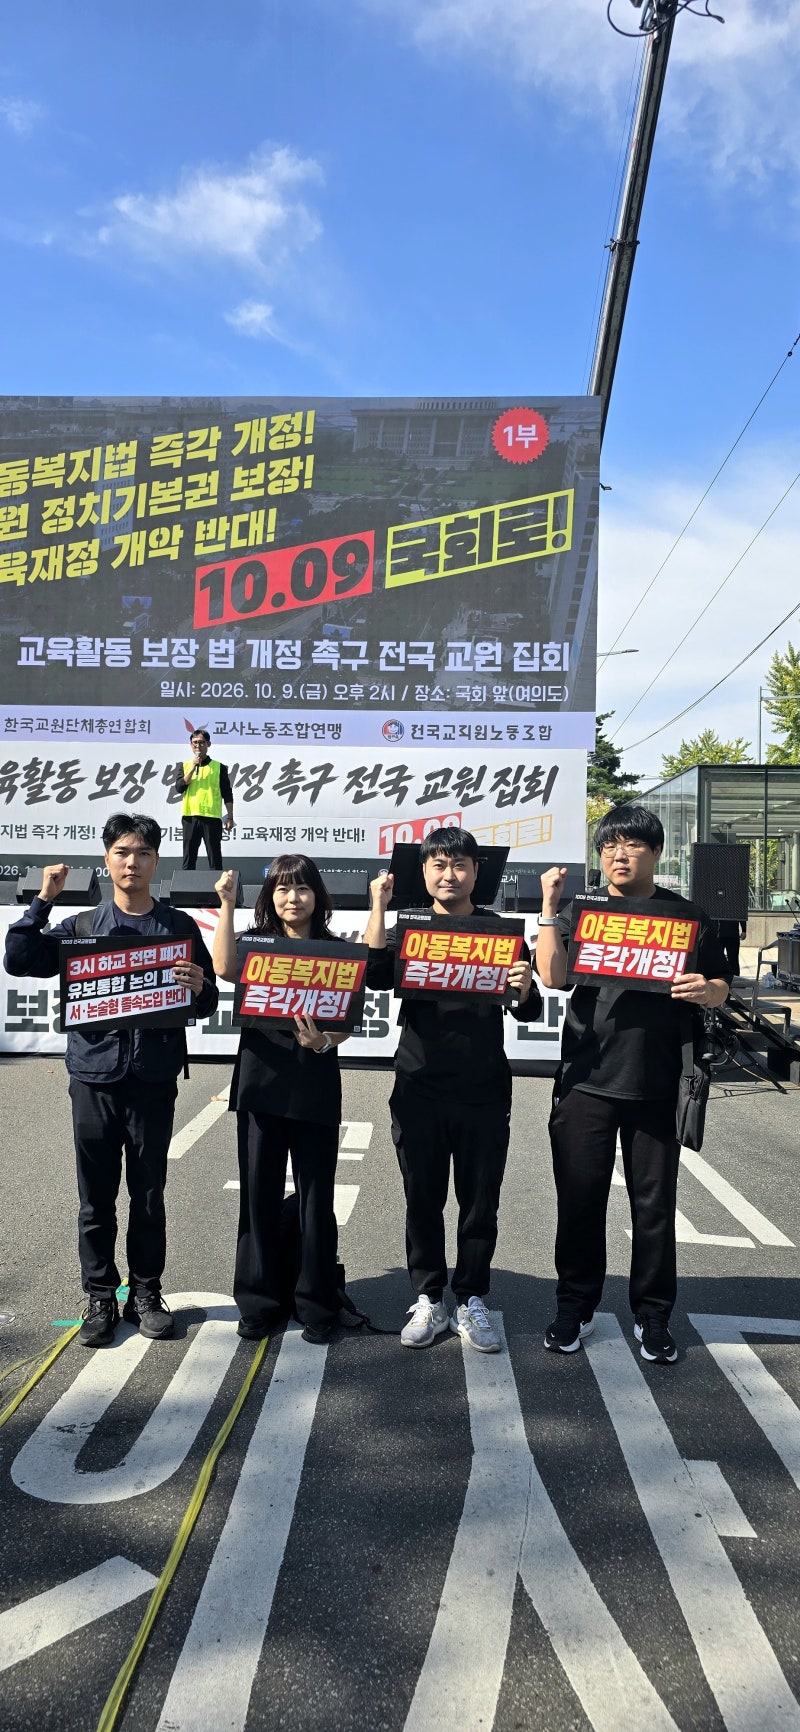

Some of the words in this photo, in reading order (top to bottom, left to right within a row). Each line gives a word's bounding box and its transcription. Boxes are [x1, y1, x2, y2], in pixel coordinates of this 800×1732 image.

[502, 424, 538, 449] 1부
[0, 440, 138, 498] 동복지법
[149, 425, 222, 468] 즉각
[231, 410, 316, 457] 개정!
[0, 502, 29, 542] 원
[41, 470, 219, 536] 정치기본권
[230, 454, 315, 502] 보장!
[0, 538, 100, 587] 육재정
[111, 524, 184, 570] 개악
[194, 508, 278, 556] 반대!
[198, 538, 371, 622] 10.09
[386, 489, 573, 588] 국회로!
[17, 636, 132, 668] 교육활동
[141, 638, 199, 669] 보장
[208, 639, 235, 669] 법
[247, 639, 301, 671] 개정
[312, 640, 368, 671] 촉구
[379, 641, 435, 672] 전국
[445, 642, 501, 672] 교원
[513, 641, 569, 673] 집회
[160, 681, 195, 698] 일시:
[201, 683, 248, 698] 2026.
[254, 683, 276, 699] 10.
[333, 684, 364, 701] 오후
[370, 684, 396, 702] 2시
[401, 685, 409, 701] /
[415, 685, 449, 702] 장소:
[456, 685, 487, 702] 국회
[492, 684, 569, 702] 앞(여의도)
[4, 717, 151, 734] 한국교원단체총연합회
[213, 721, 342, 740] 교사노동조합연맹
[411, 724, 552, 741] 전국교직원노동조합
[0, 757, 88, 805] 육활동
[88, 759, 158, 804] 보장
[272, 758, 339, 806] 촉구
[343, 763, 415, 808] 전국
[415, 765, 488, 808] 교원
[489, 765, 559, 808] 집회
[1, 824, 28, 839] 지법
[32, 824, 60, 840] 즉각
[63, 825, 96, 840] 개정!
[241, 827, 297, 842] 교육재정
[301, 827, 329, 842] 개악
[332, 827, 365, 843] 반대!
[580, 913, 693, 950] 아동복지법
[70, 957, 95, 976] 3시
[98, 953, 126, 971] 하교
[129, 948, 157, 967] 전면
[160, 943, 187, 962] 폐지
[405, 932, 516, 966] 아동복지법
[578, 943, 688, 979] 즉각개정!
[68, 975, 126, 1000] 유보통합
[129, 971, 158, 990] 논의
[246, 955, 360, 990] 아동복지법
[405, 960, 510, 991] 즉각개정!
[121, 991, 163, 1014] 졸속도입
[166, 988, 187, 1004] 반대
[244, 984, 353, 1018] 즉각개정!
